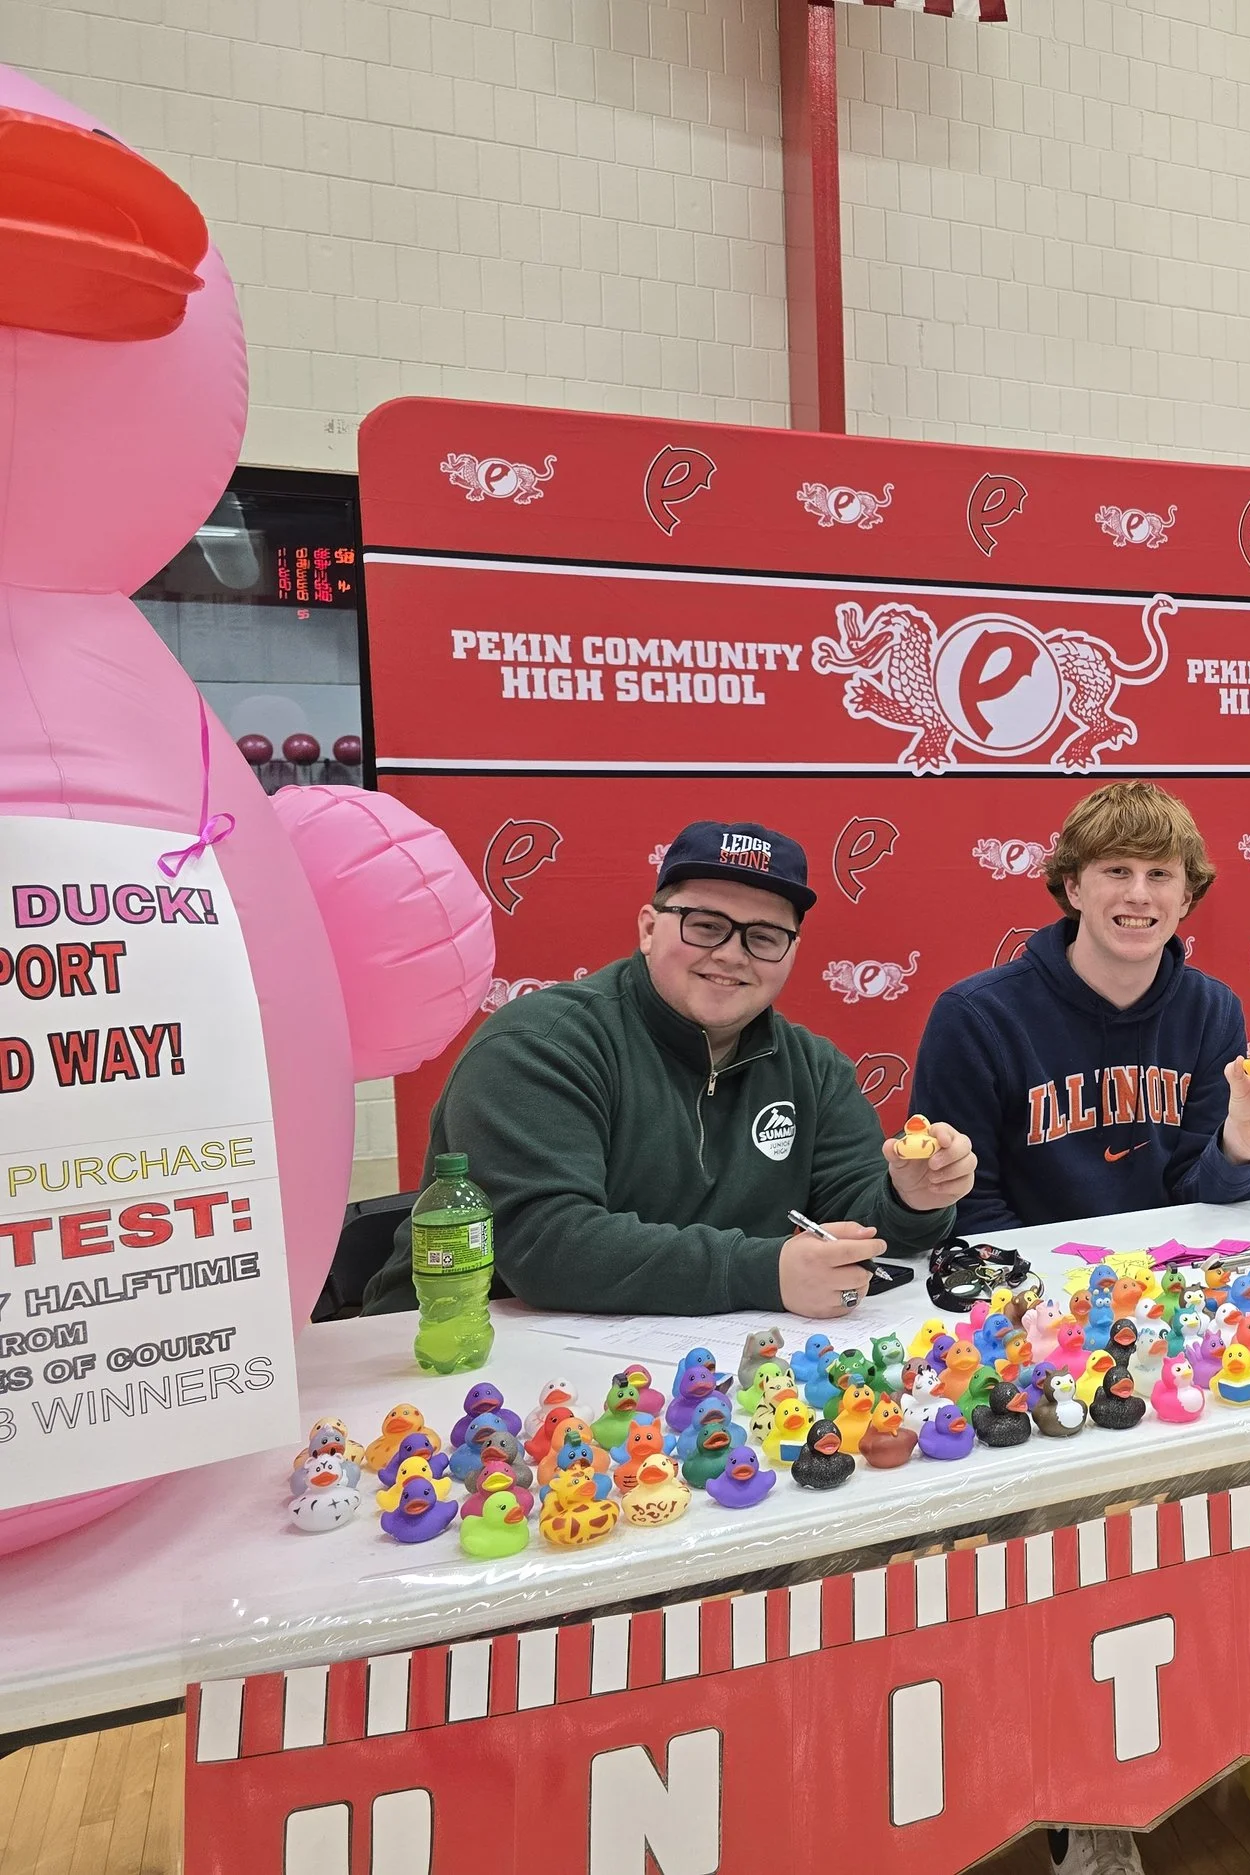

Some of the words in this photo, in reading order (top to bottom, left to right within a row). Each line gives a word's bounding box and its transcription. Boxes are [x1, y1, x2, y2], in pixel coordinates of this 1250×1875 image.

[451, 629, 572, 664] PEKIN
[582, 635, 803, 671] COMMUNITY
[501, 666, 604, 702] HIGH
[615, 670, 766, 706] SCHOOL
[720, 833, 772, 858] LEDGE
[720, 850, 771, 872] STONE
[12, 884, 219, 928] DUCK!
[47, 1022, 186, 1088] WAY!
[8, 1137, 256, 1197] PURCHASE
[25, 1252, 261, 1318] HALFTIME
[43, 1353, 97, 1385] OF
[106, 1326, 237, 1373] COURT
[32, 1357, 275, 1434] WINNERS
